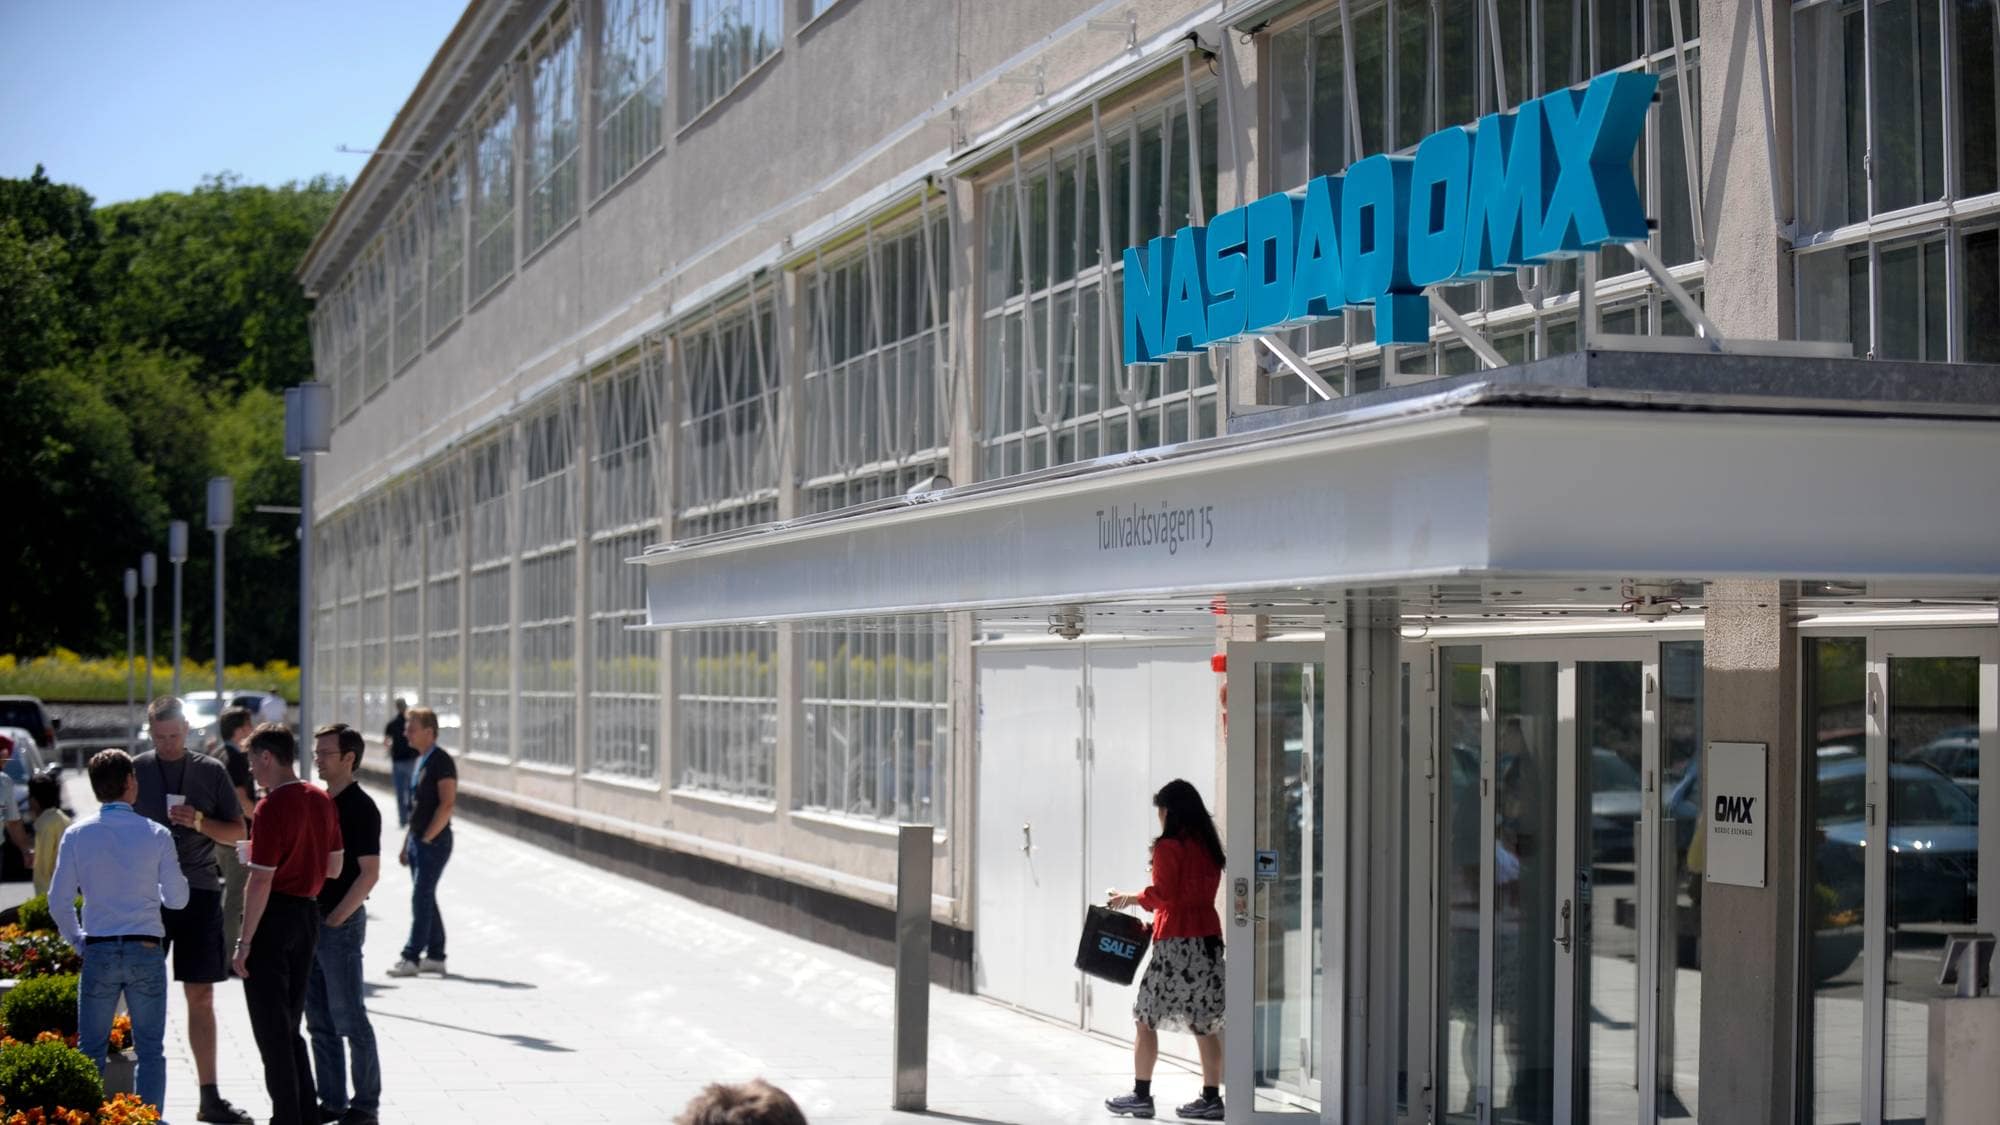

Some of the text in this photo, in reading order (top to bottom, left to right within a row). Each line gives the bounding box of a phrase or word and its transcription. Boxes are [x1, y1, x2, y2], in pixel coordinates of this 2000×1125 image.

[1124, 71, 1655, 366] NASDAQ OMX
[1096, 500, 1214, 556] Tullvaktsvägen 15
[1715, 795, 1755, 824] OMX
[1098, 936, 1136, 960] SALE
